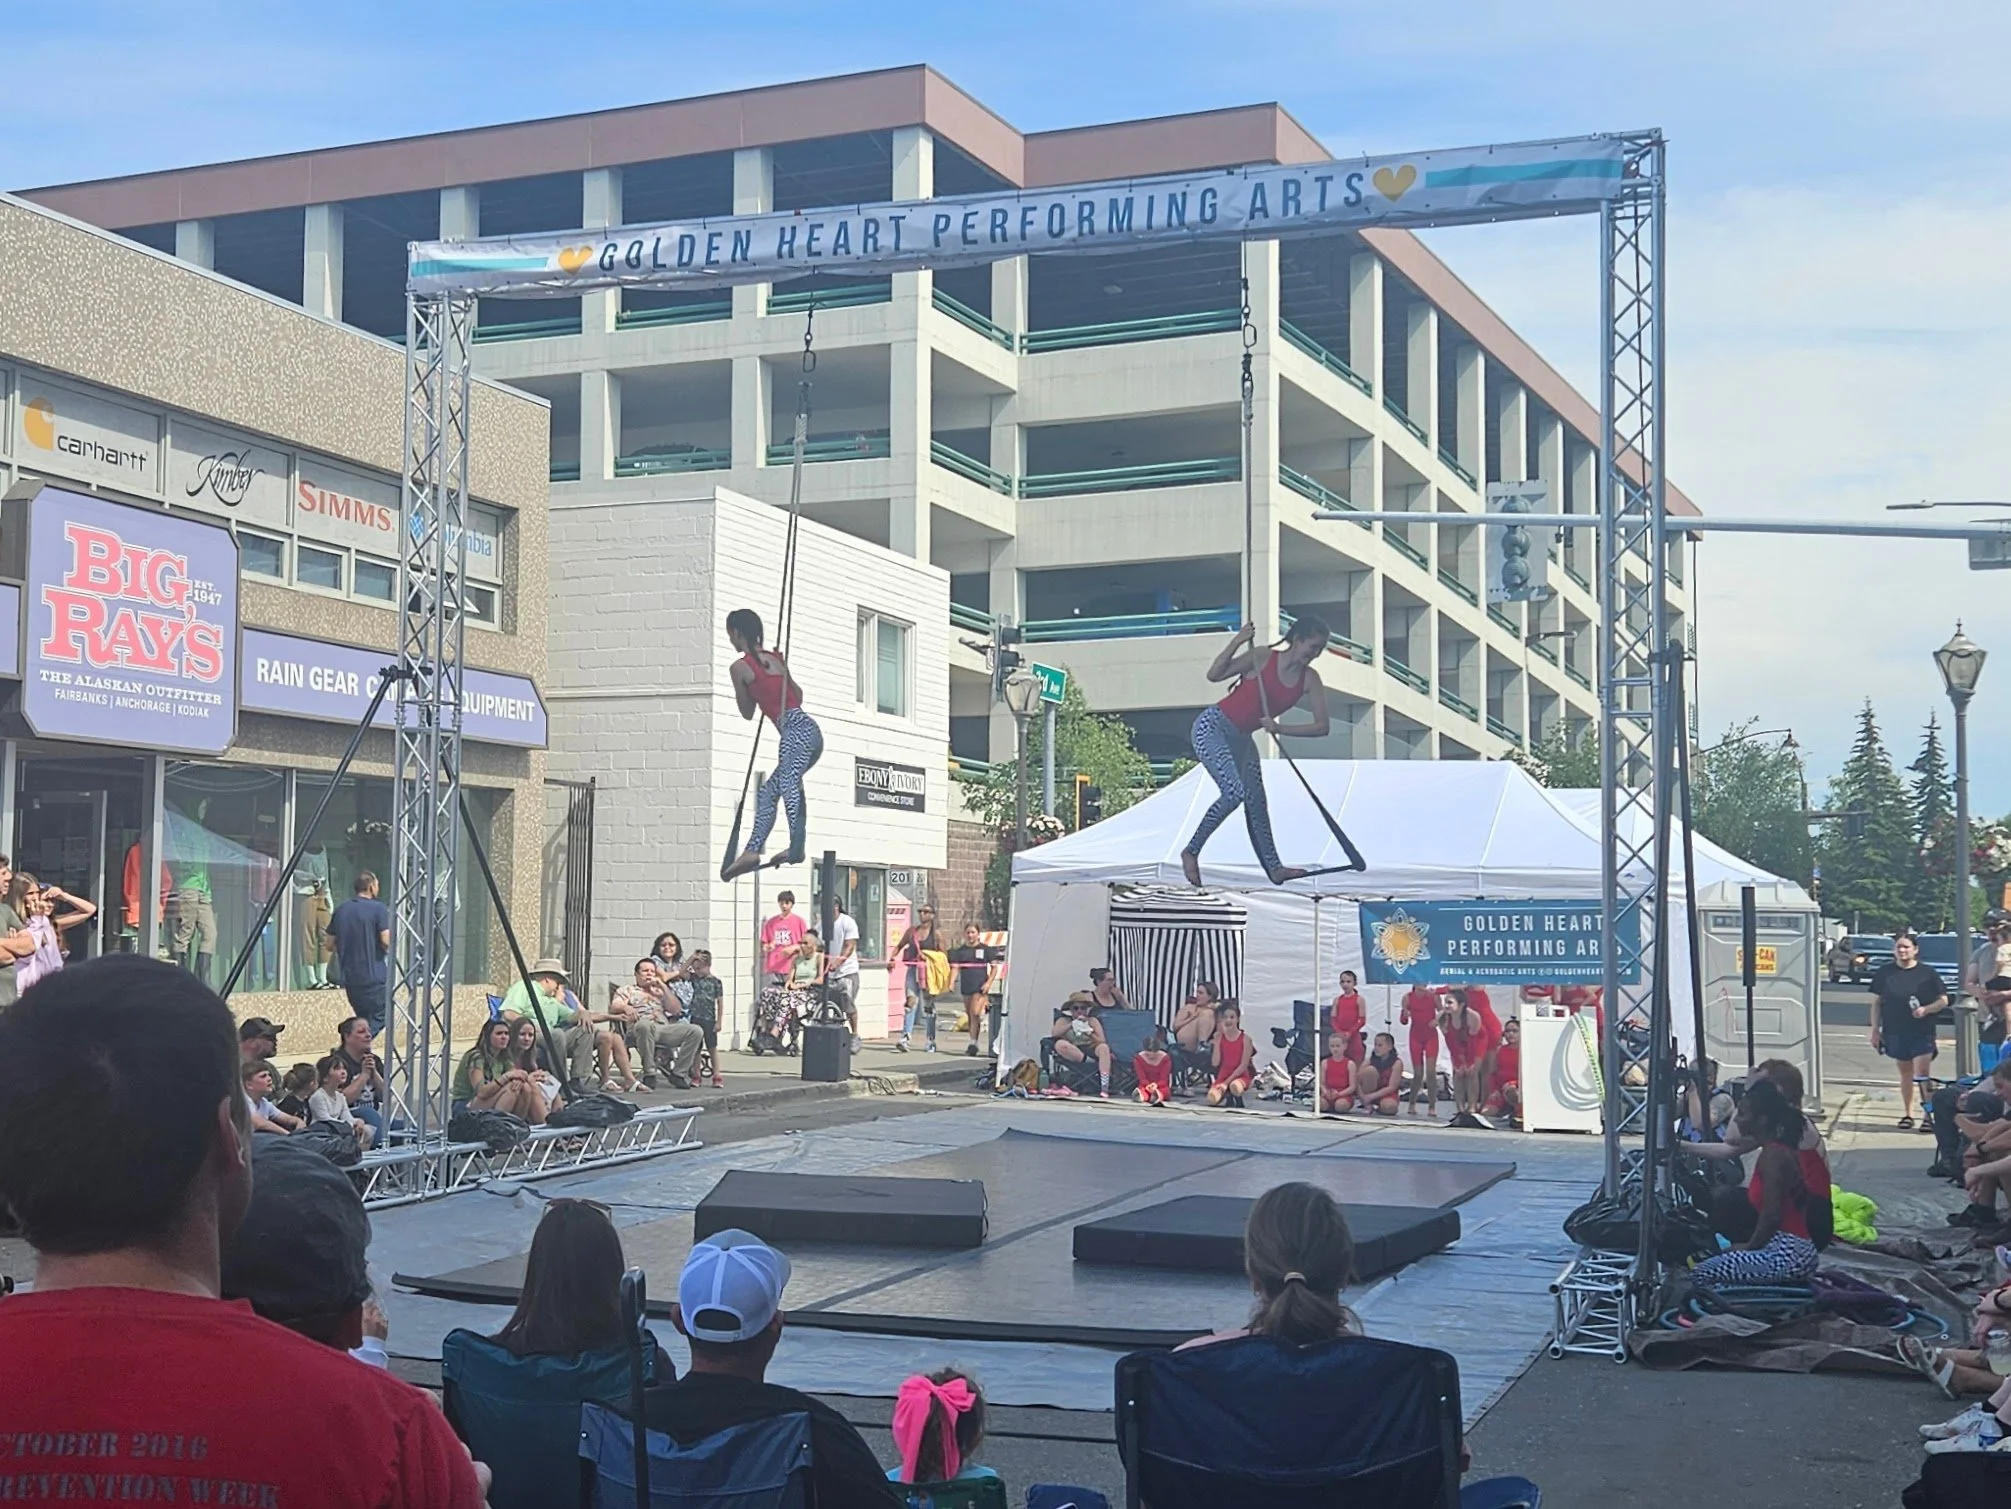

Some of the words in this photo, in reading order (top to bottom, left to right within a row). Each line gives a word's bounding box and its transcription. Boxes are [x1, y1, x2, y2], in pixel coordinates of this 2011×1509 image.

[599, 229, 752, 272] GOLDEN
[776, 214, 907, 260] HEART
[933, 187, 1218, 249] PERFORMING
[1248, 172, 1364, 220] ARTS
[57, 434, 147, 472] carhartt
[186, 450, 265, 507] Kimber
[298, 479, 391, 532] SIMMS
[64, 520, 193, 610] BIG
[193, 589, 222, 606] 1947
[40, 583, 224, 684] RAY'S
[40, 669, 72, 685] THE
[74, 675, 142, 694] ALASKAN
[146, 684, 222, 706] OUTFITTER
[256, 657, 303, 688] RAIN
[309, 667, 359, 696] GEAR
[55, 688, 108, 706] FAIRBANKS
[115, 697, 171, 714] ANCHORAGE
[177, 705, 210, 718] KODIAK
[858, 767, 889, 787] EBONY
[897, 774, 923, 791] IVORY
[1464, 914, 1534, 932] GOLDEN
[1544, 914, 1604, 932] HEART
[1447, 939, 1566, 956] PERFORMING
[1576, 939, 1622, 956] AR
[190, 1476, 281, 1509] WEEK
